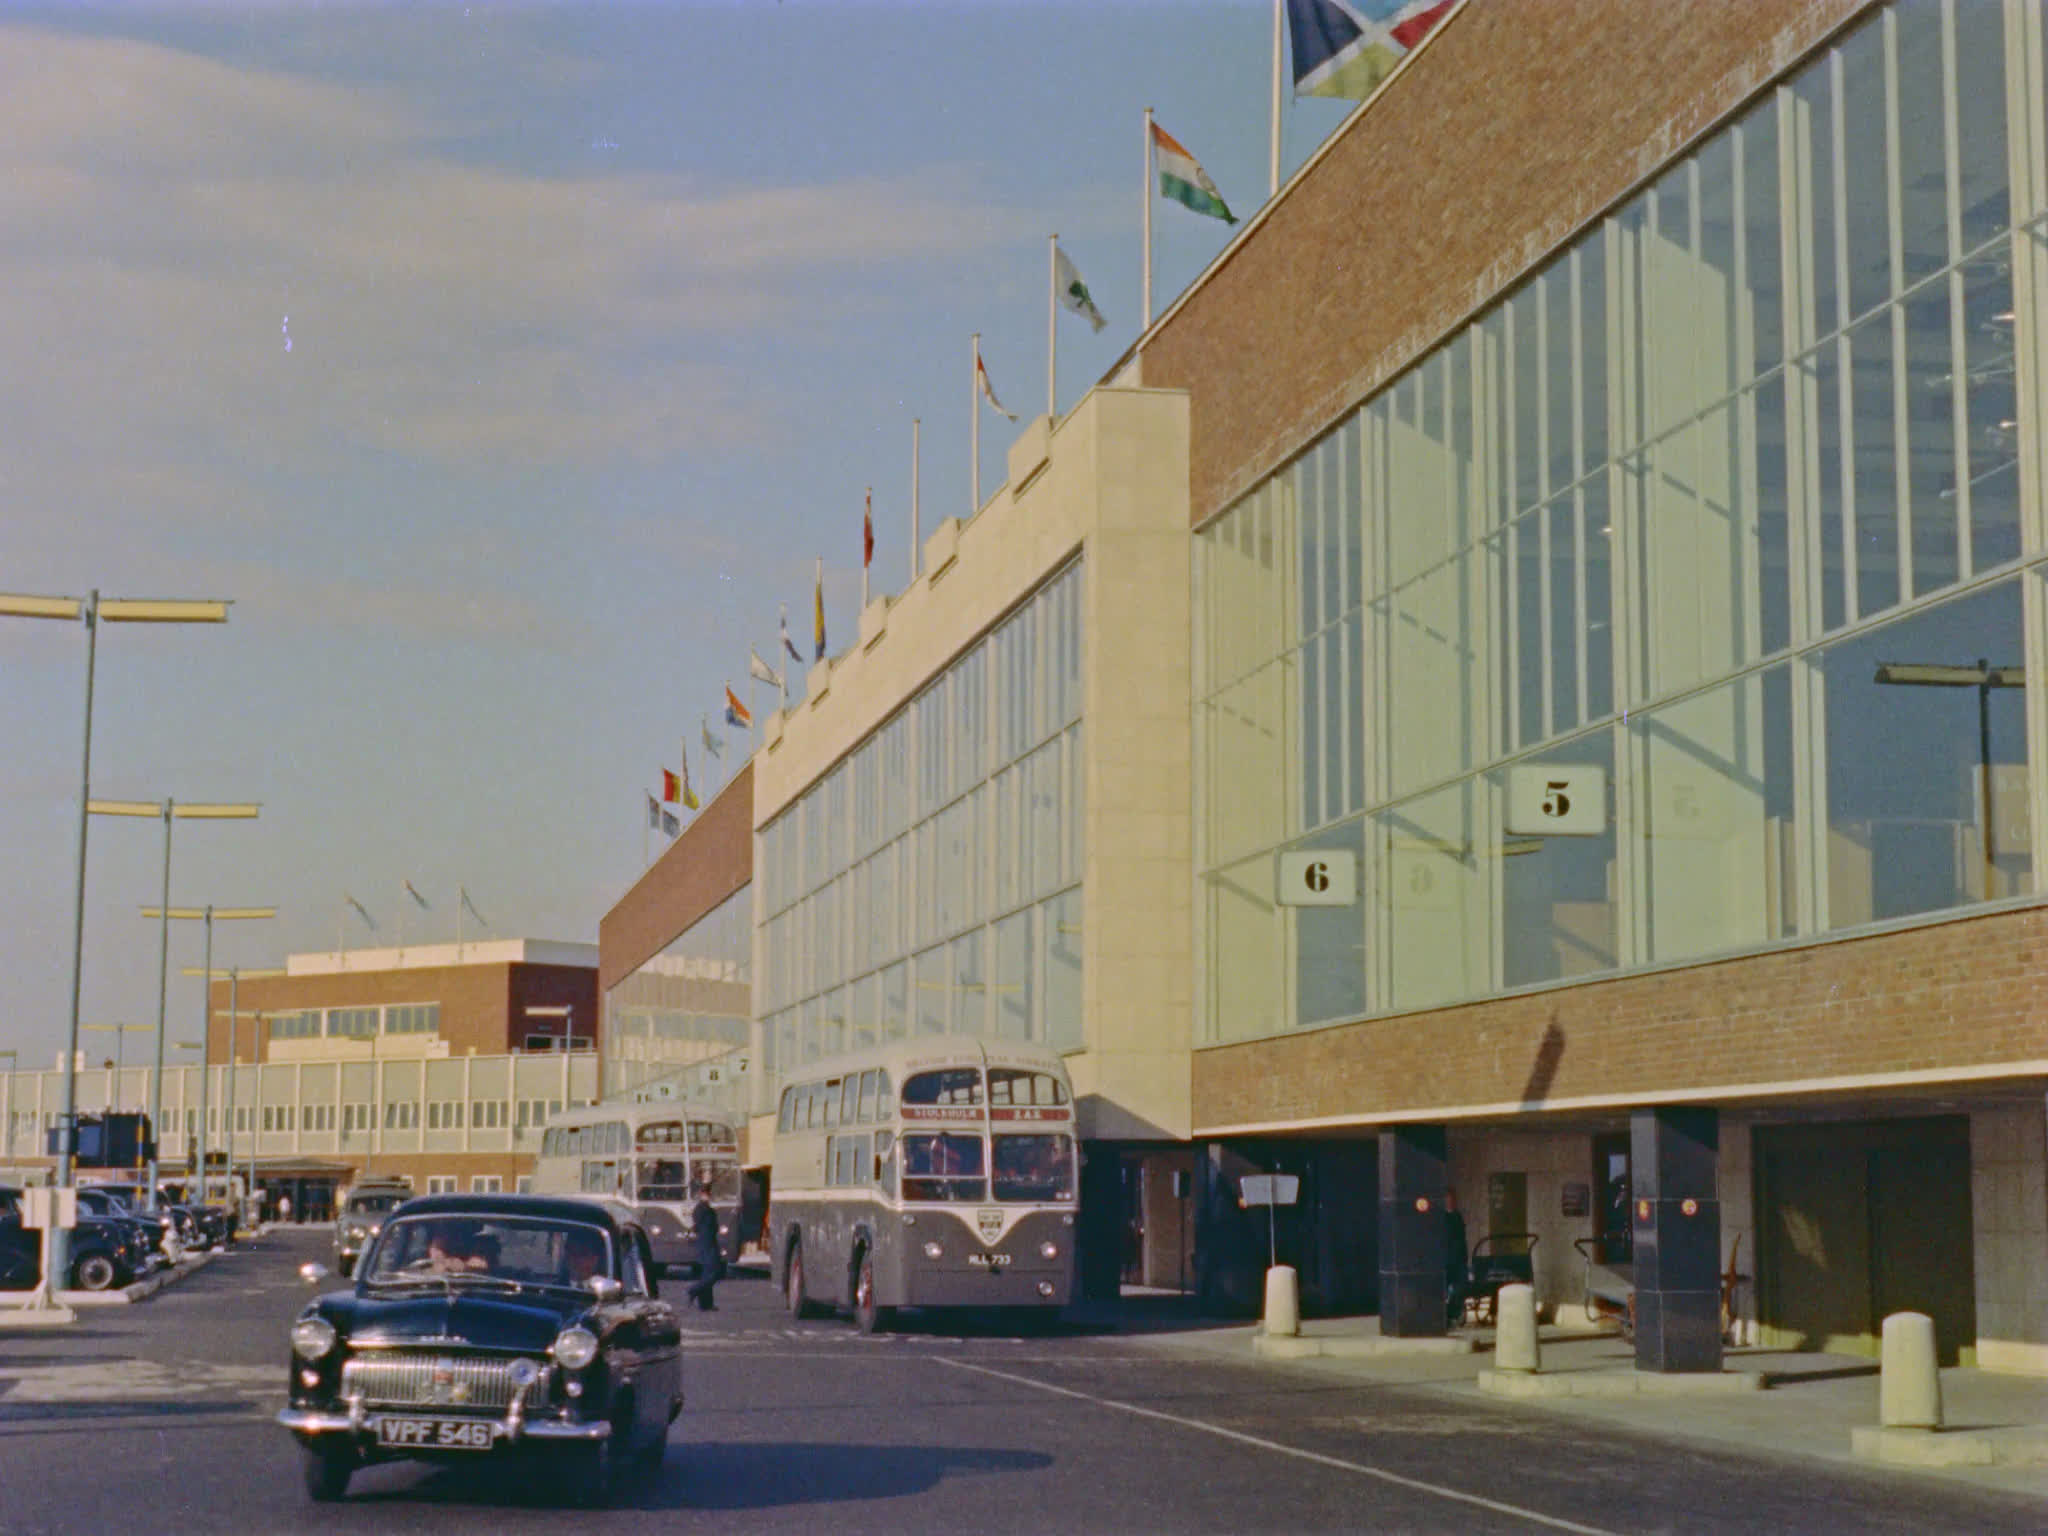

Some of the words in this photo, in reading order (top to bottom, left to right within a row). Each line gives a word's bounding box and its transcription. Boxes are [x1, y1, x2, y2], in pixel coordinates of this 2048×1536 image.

[1541, 781, 1571, 818] 5
[1304, 861, 1329, 893] 6
[385, 1420, 432, 1443] VPF
[436, 1423, 489, 1446] 546
